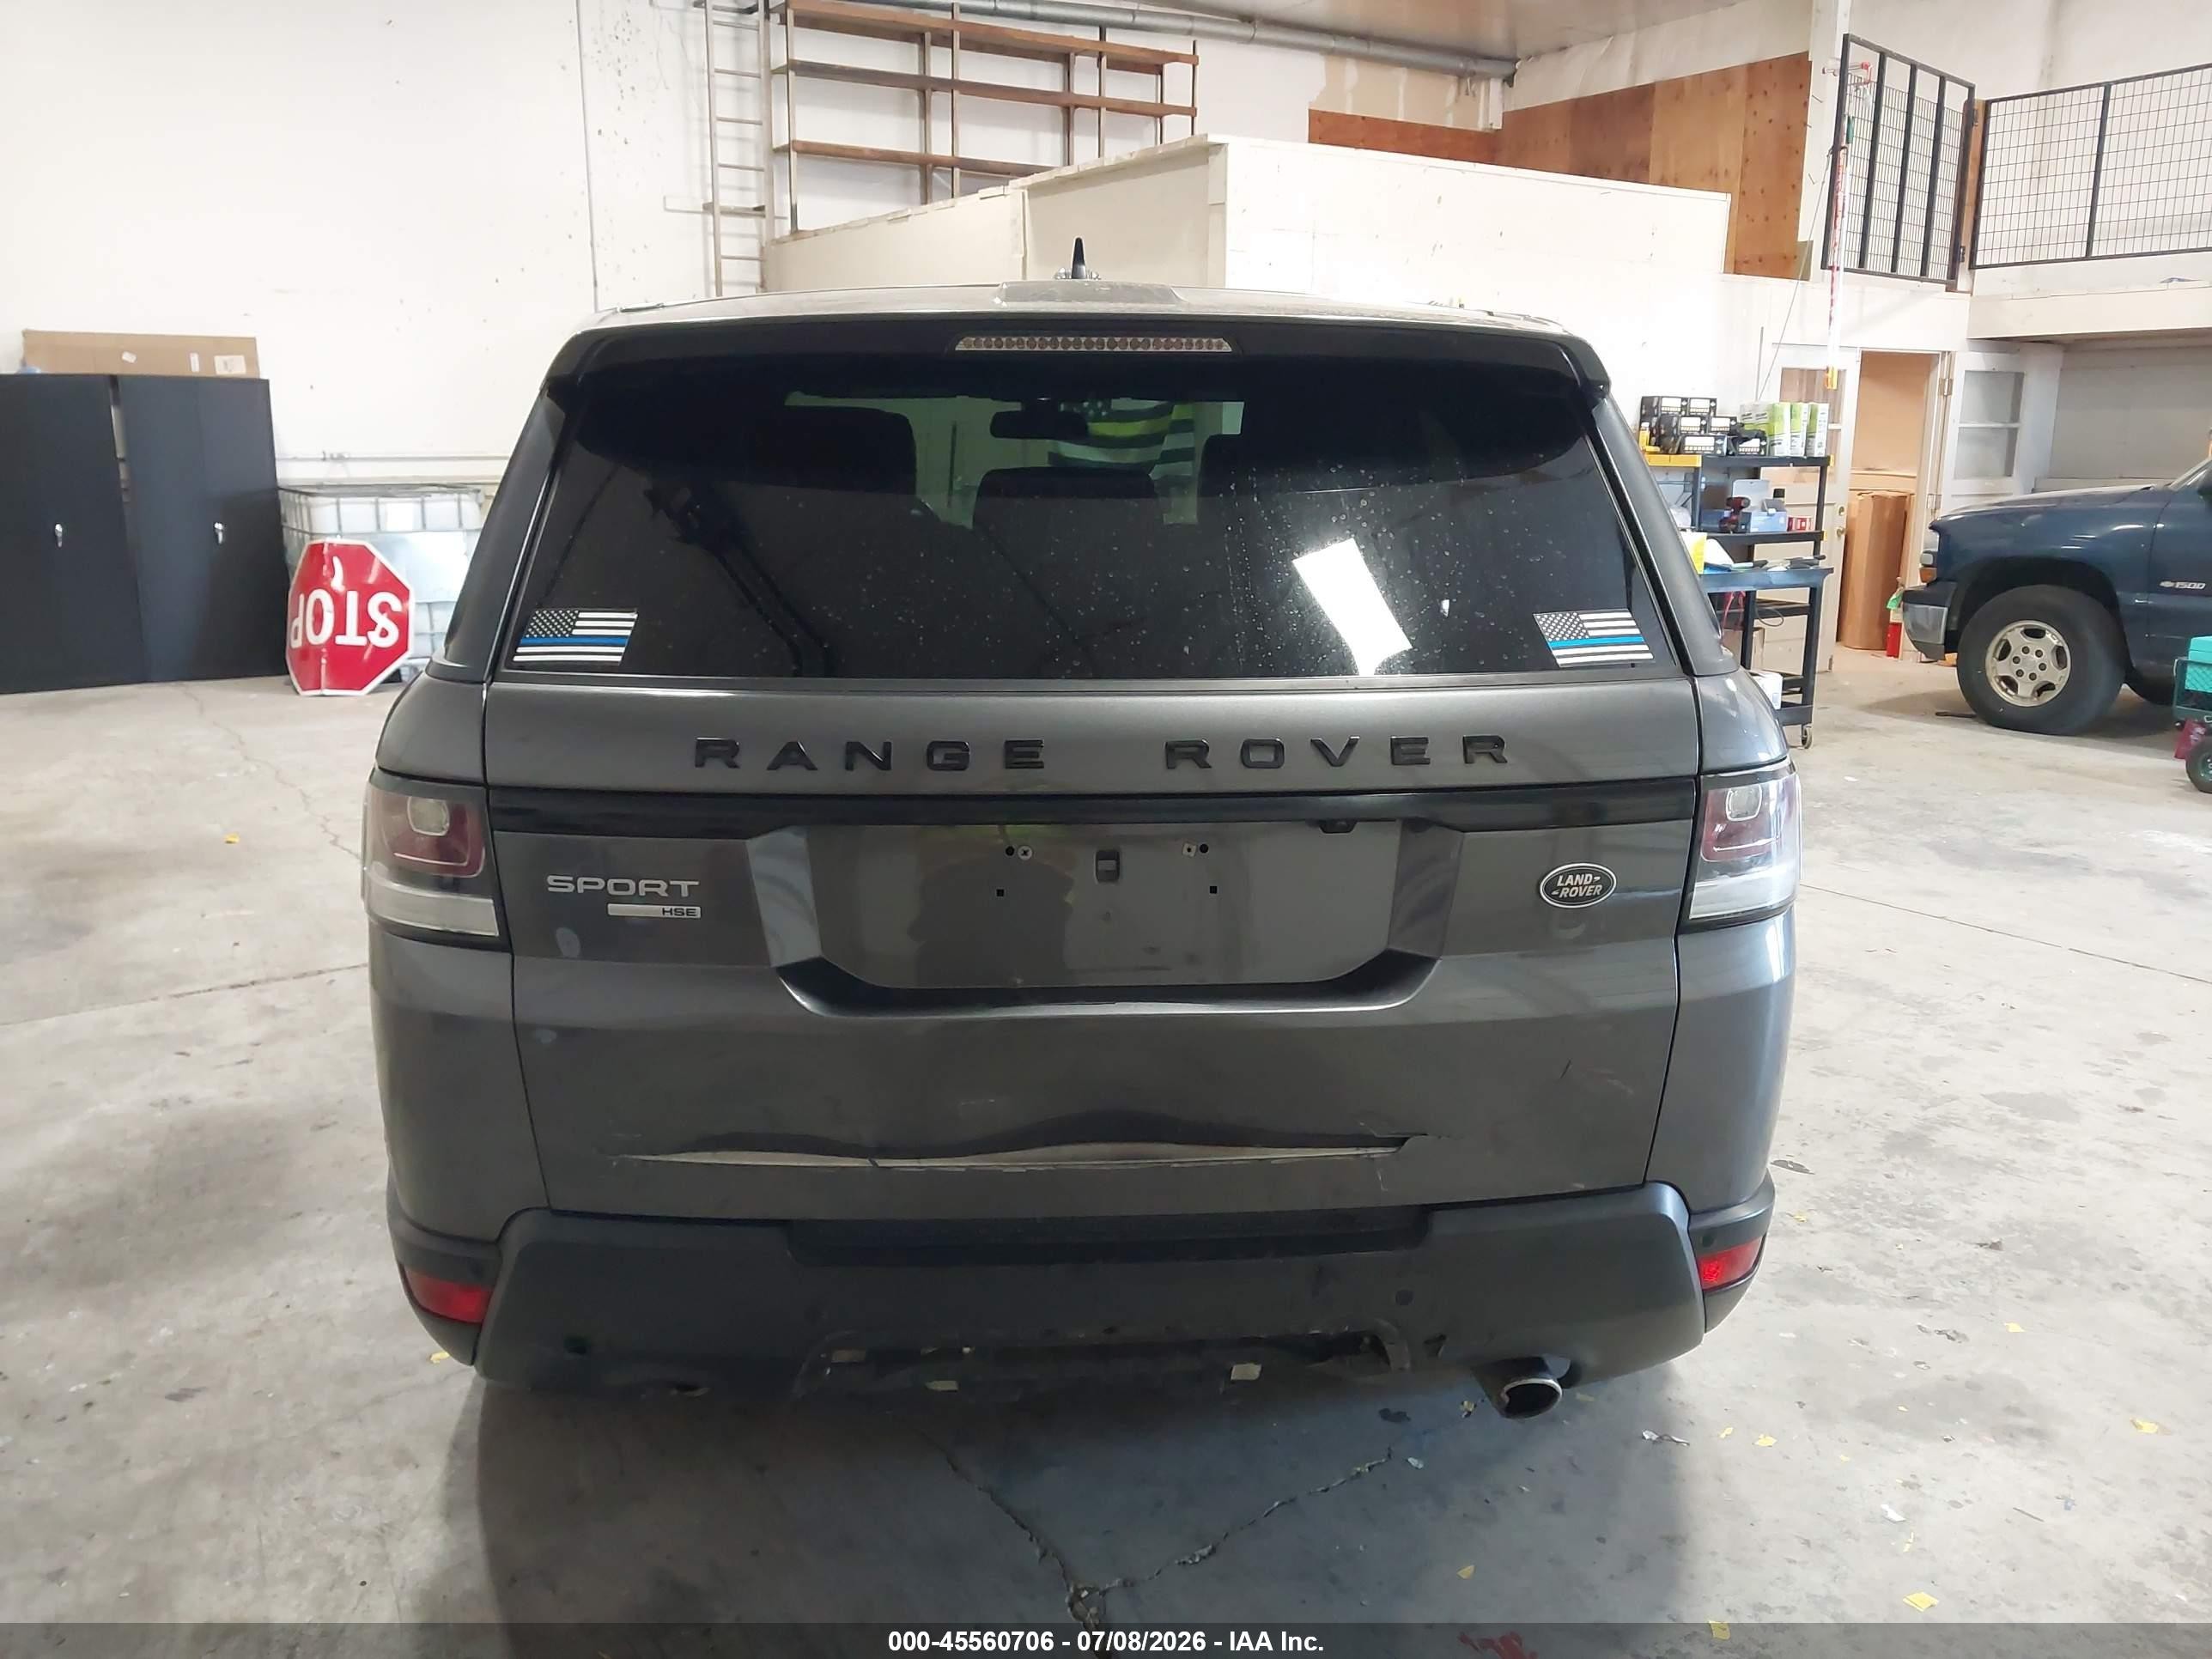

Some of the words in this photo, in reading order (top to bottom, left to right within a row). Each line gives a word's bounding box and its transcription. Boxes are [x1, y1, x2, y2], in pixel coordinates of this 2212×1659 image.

[289, 587, 403, 649] STOP
[694, 737, 1045, 771] RANGE
[1164, 734, 1509, 769] ROVER
[546, 874, 700, 897] SPORT
[662, 907, 697, 917] HSE
